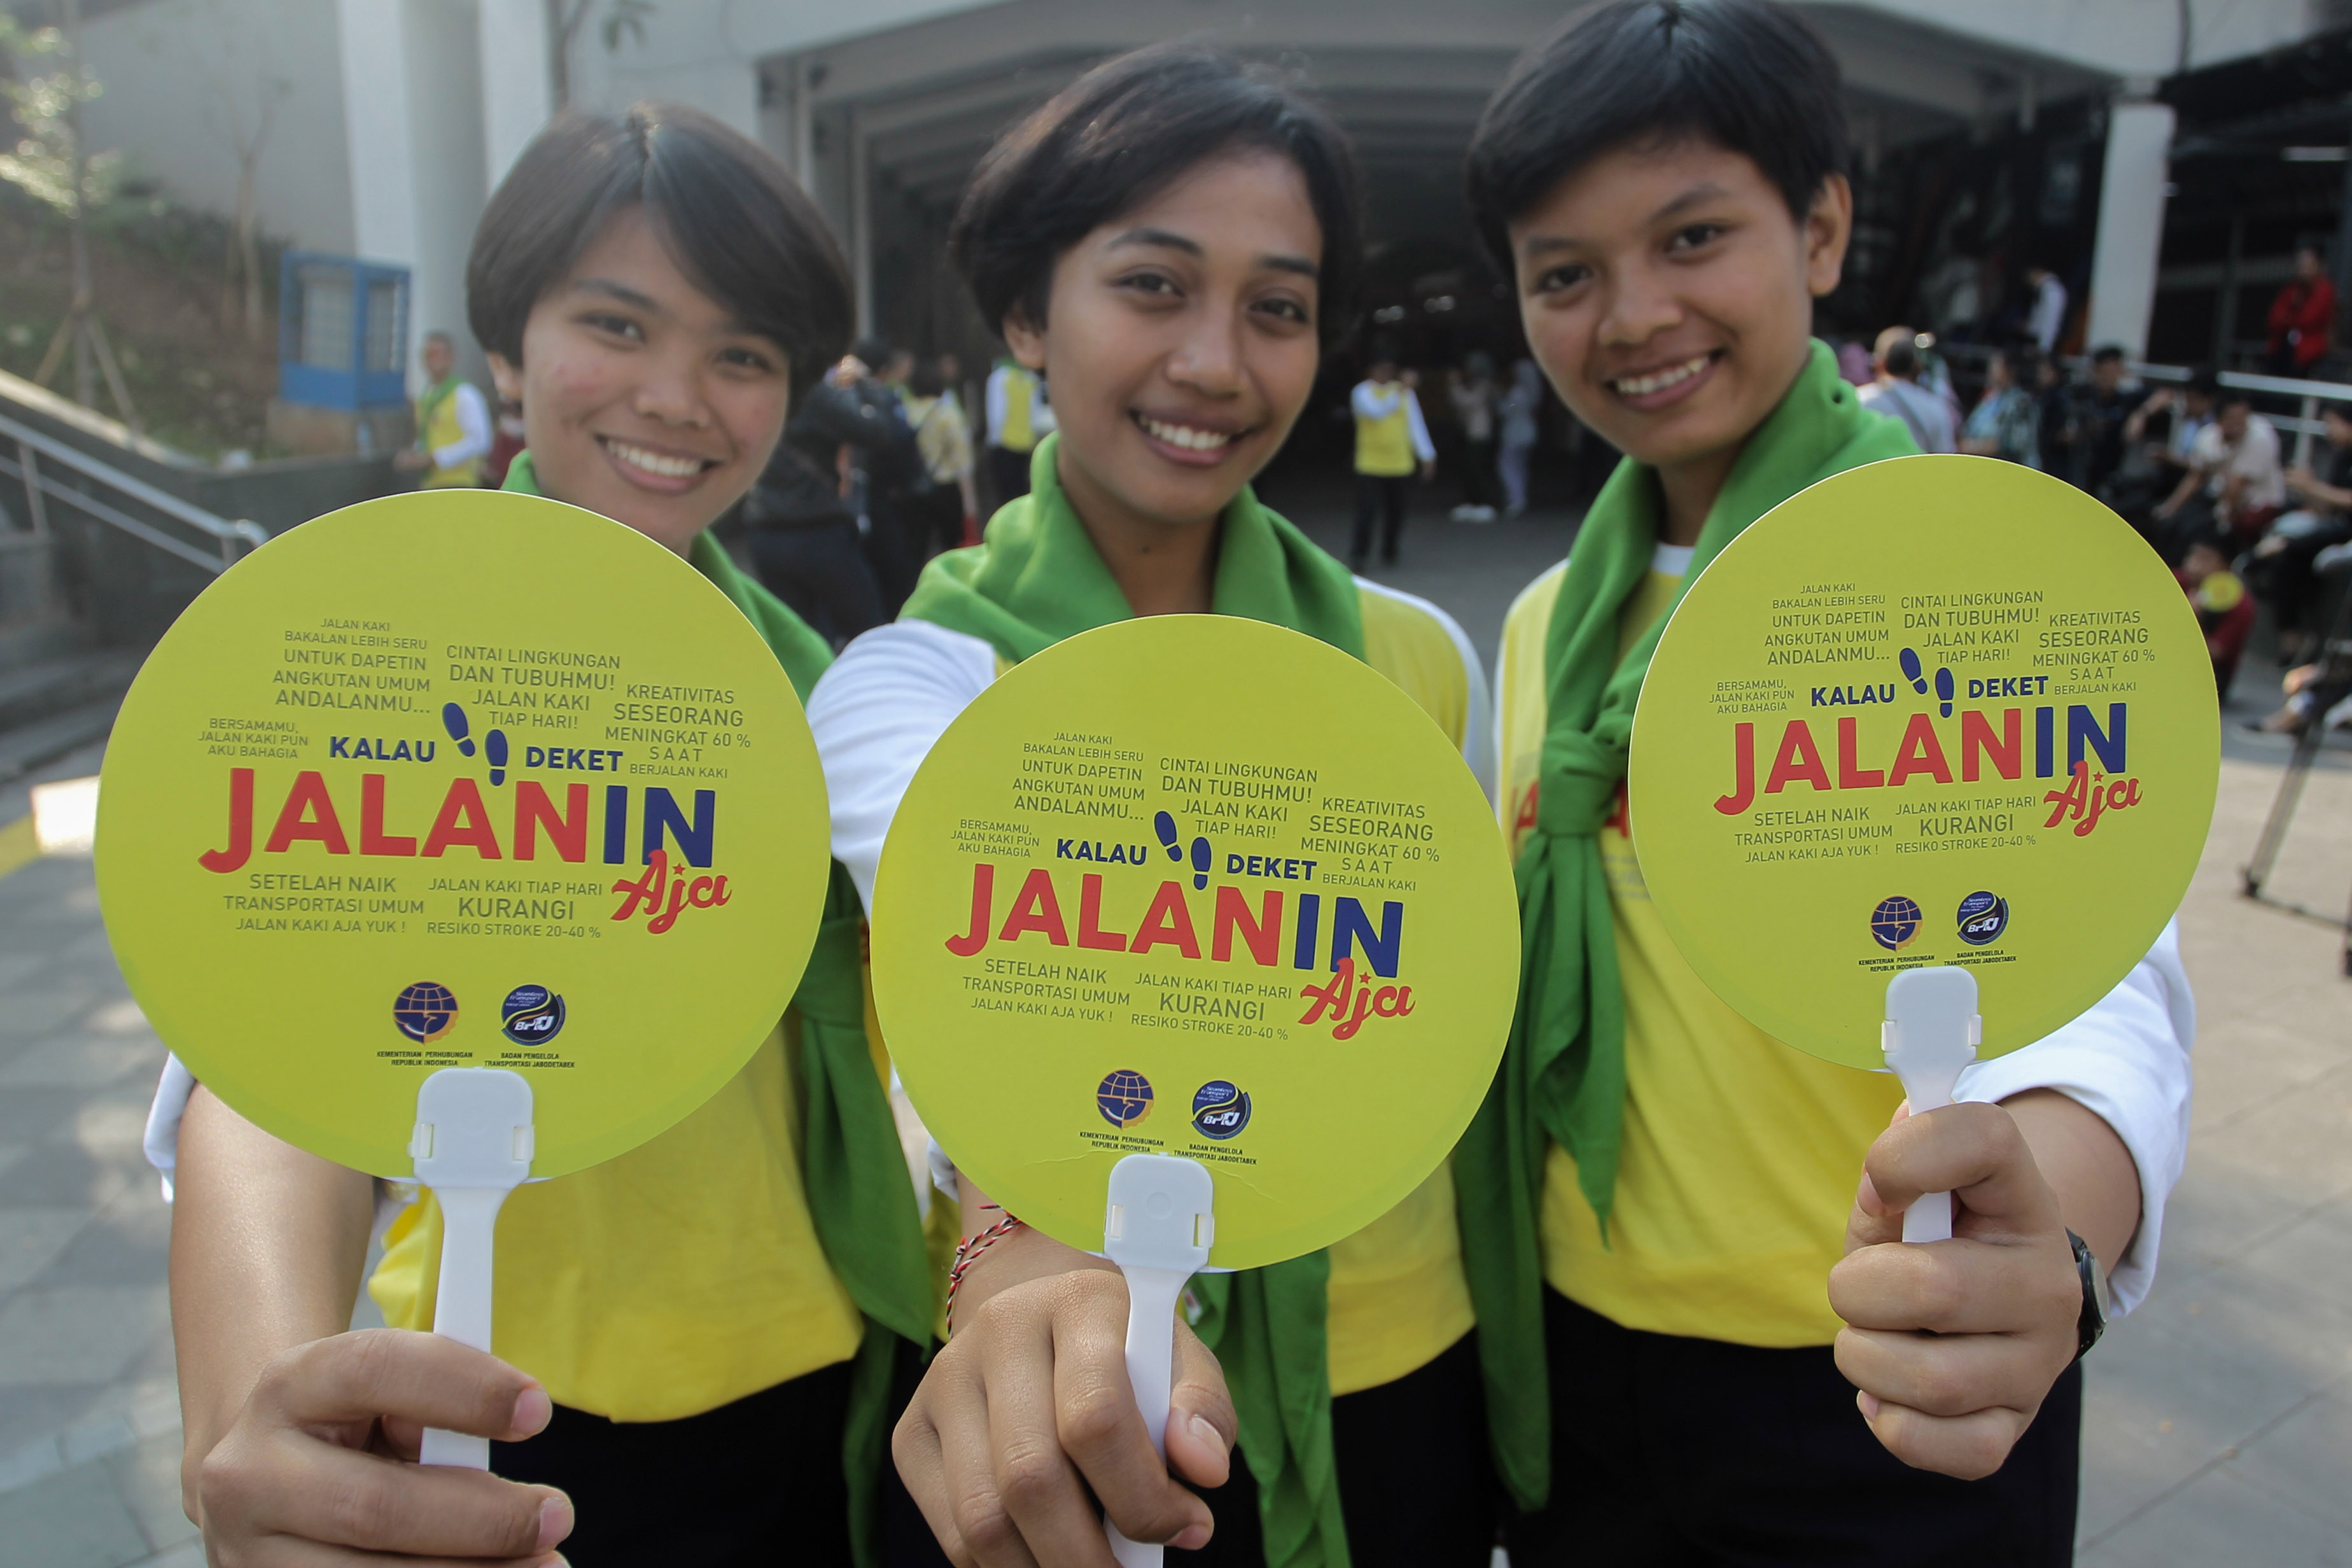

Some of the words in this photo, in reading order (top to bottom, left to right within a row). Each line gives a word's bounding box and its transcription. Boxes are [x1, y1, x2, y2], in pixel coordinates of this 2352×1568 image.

[1772, 598, 1821, 609] BAKALAN
[1824, 596, 1855, 606] LEBIH
[1858, 594, 1886, 605] SERU
[1901, 594, 1946, 609] CINTAI
[1951, 590, 2043, 607] LINGKUNGAN
[1772, 613, 1821, 627] UNTUK
[1826, 610, 1885, 626] DAPETIN
[1904, 612, 1940, 629] DAN
[1945, 607, 2039, 627] TUBUHMU!
[2049, 610, 2141, 627] KREATIVITAS
[1764, 631, 1841, 647] ANGKUTAN
[1846, 629, 1889, 643] UMUM
[1922, 631, 1975, 648] JALAN
[1981, 629, 2019, 645] KAKI
[2039, 627, 2148, 648] SESEORANG
[284, 648, 346, 666] UNTUK
[351, 653, 426, 671] DAPETIN
[446, 645, 502, 661] CINTAI
[508, 648, 620, 669] LINGKUNGAN
[1767, 646, 1890, 666] ANDALANMU...
[1936, 650, 1968, 664] TIAP
[1973, 648, 2010, 662] HARI!
[2033, 650, 2119, 667] MENINGKAT
[2122, 649, 2139, 662] 60
[272, 669, 370, 689] ANGKUTAN
[376, 676, 430, 692] UMUM
[449, 664, 494, 683] DAN
[501, 667, 615, 690] TUBUHMU!
[2069, 666, 2115, 681] SAAT
[274, 689, 430, 713] ANDALANMU...
[471, 689, 536, 708] JALAN
[544, 693, 589, 711] KAKI
[626, 683, 734, 704] KREATIVITAS
[1811, 683, 1895, 707] KALAU
[1968, 675, 2049, 699] DEKET
[488, 711, 527, 726] TIAP
[532, 713, 578, 729] HARI!
[613, 703, 743, 727] SESEORANG
[605, 726, 708, 745] MENINGKAT
[713, 732, 731, 747] 60
[1053, 732, 1086, 743] JALAN
[1088, 734, 1112, 745] KAKI
[329, 736, 435, 763] KALAU
[525, 746, 624, 772] DEKET
[1023, 743, 1075, 756] BAKALAN
[1078, 747, 1111, 759] LEBIH
[1114, 750, 1144, 762] SERU
[1713, 702, 2127, 815] JALANIN
[1022, 759, 1074, 776] UNTUK
[1078, 764, 1142, 781] DAPETIN
[1160, 757, 1210, 774] CINTAI
[1214, 761, 1317, 783] LINGKUNGAN
[1012, 778, 1094, 797] ANGKUTAN
[1098, 785, 1145, 801] UMUM
[1162, 775, 1201, 794] DAN
[1208, 778, 1312, 804] TUBUHMU!
[2043, 760, 2141, 837] Aja
[1013, 795, 1144, 821] ANDALANMU...
[1180, 799, 1240, 818] JALAN
[1245, 804, 1287, 822] KAKI
[1322, 797, 1425, 819] KREATIVITAS
[1895, 802, 1936, 815] JALAN
[1941, 799, 1970, 813] KAKI
[1973, 798, 2003, 810] TIAP
[2006, 796, 2036, 809] HARI
[198, 767, 716, 874] JALANIN
[960, 818, 1032, 836] BERSAMAMU,
[1754, 809, 1826, 827] SETELAH
[1831, 806, 1870, 822] NAIK
[1920, 813, 2013, 837] KURANGI
[950, 830, 986, 842] JALAN
[988, 833, 1014, 844] KAKI
[1016, 836, 1040, 847] PUN
[1195, 819, 1230, 835] TIAP
[1234, 823, 1276, 839] HARI!
[1309, 815, 1433, 841] SESEORANG
[1734, 827, 1844, 846] TRANSPORTASI
[1848, 825, 1893, 839] UMUM
[957, 842, 981, 853] AKU
[983, 844, 1031, 858] BAHAGIA
[1301, 836, 1399, 858] MENINGKAT
[1403, 846, 1421, 860] 60
[1425, 847, 1439, 862] %
[1896, 841, 1938, 853] RESIKO
[1942, 837, 1989, 851] STROKE
[1991, 836, 2022, 848] 20-40
[1056, 838, 1147, 865] KALAU
[1226, 853, 1317, 881] DEKET
[1341, 857, 1393, 874] SAAT
[249, 873, 341, 892] SETELAH
[349, 876, 396, 893] NAIK
[428, 878, 480, 892] JALAN
[485, 879, 522, 893] KAKI
[526, 881, 561, 894] TIAP
[566, 882, 603, 896] HARI
[612, 848, 731, 934] Aja
[1322, 873, 1385, 889] BERJALAN
[1388, 879, 1416, 892] KAKI
[223, 895, 362, 913] TRANSPORTASI
[368, 899, 424, 914] UMUM
[458, 897, 573, 920] KURANGI
[235, 918, 287, 930] JALAN
[292, 919, 328, 932] KAKI
[332, 920, 361, 932] AJA
[366, 920, 396, 933] YUK
[427, 921, 480, 935] RESIKO
[484, 923, 542, 937] STROKE
[545, 925, 584, 937] 20-40
[944, 863, 1404, 978] JALANIN
[984, 958, 1060, 980] SETELAH
[1066, 966, 1107, 984] NAIK
[962, 976, 1077, 1000] TRANSPORTASI
[1082, 988, 1130, 1006] UMUM
[1135, 972, 1180, 988] JALAN
[1185, 977, 1218, 992] KAKI
[1222, 981, 1254, 995] TIAP
[1258, 984, 1292, 1000] HARI
[1159, 992, 1264, 1021] KURANGI
[1299, 956, 1414, 1040] Aja
[970, 997, 1013, 1012] JALAN
[1016, 1002, 1047, 1016] KAKI
[1050, 1005, 1075, 1019] AJA
[1079, 1007, 1105, 1021] YUK
[1131, 1013, 1179, 1029] RESIKO
[1182, 1019, 1235, 1035] STROKE
[1237, 1025, 1273, 1039] 20-40
[1277, 1028, 1288, 1040] %
[1079, 1131, 1119, 1142] KEMENTERIAN
[1121, 1136, 1165, 1147] PERHUBUNGAN
[1091, 1140, 1119, 1149] REPUBLIK
[1119, 1144, 1151, 1153] INDONESIA
[1189, 1143, 1209, 1152] BADAN
[1209, 1145, 1243, 1156] PENGELOLA
[1173, 1149, 1217, 1161] TRANSPORTASI
[1217, 1155, 1257, 1165] JABODETABEK
